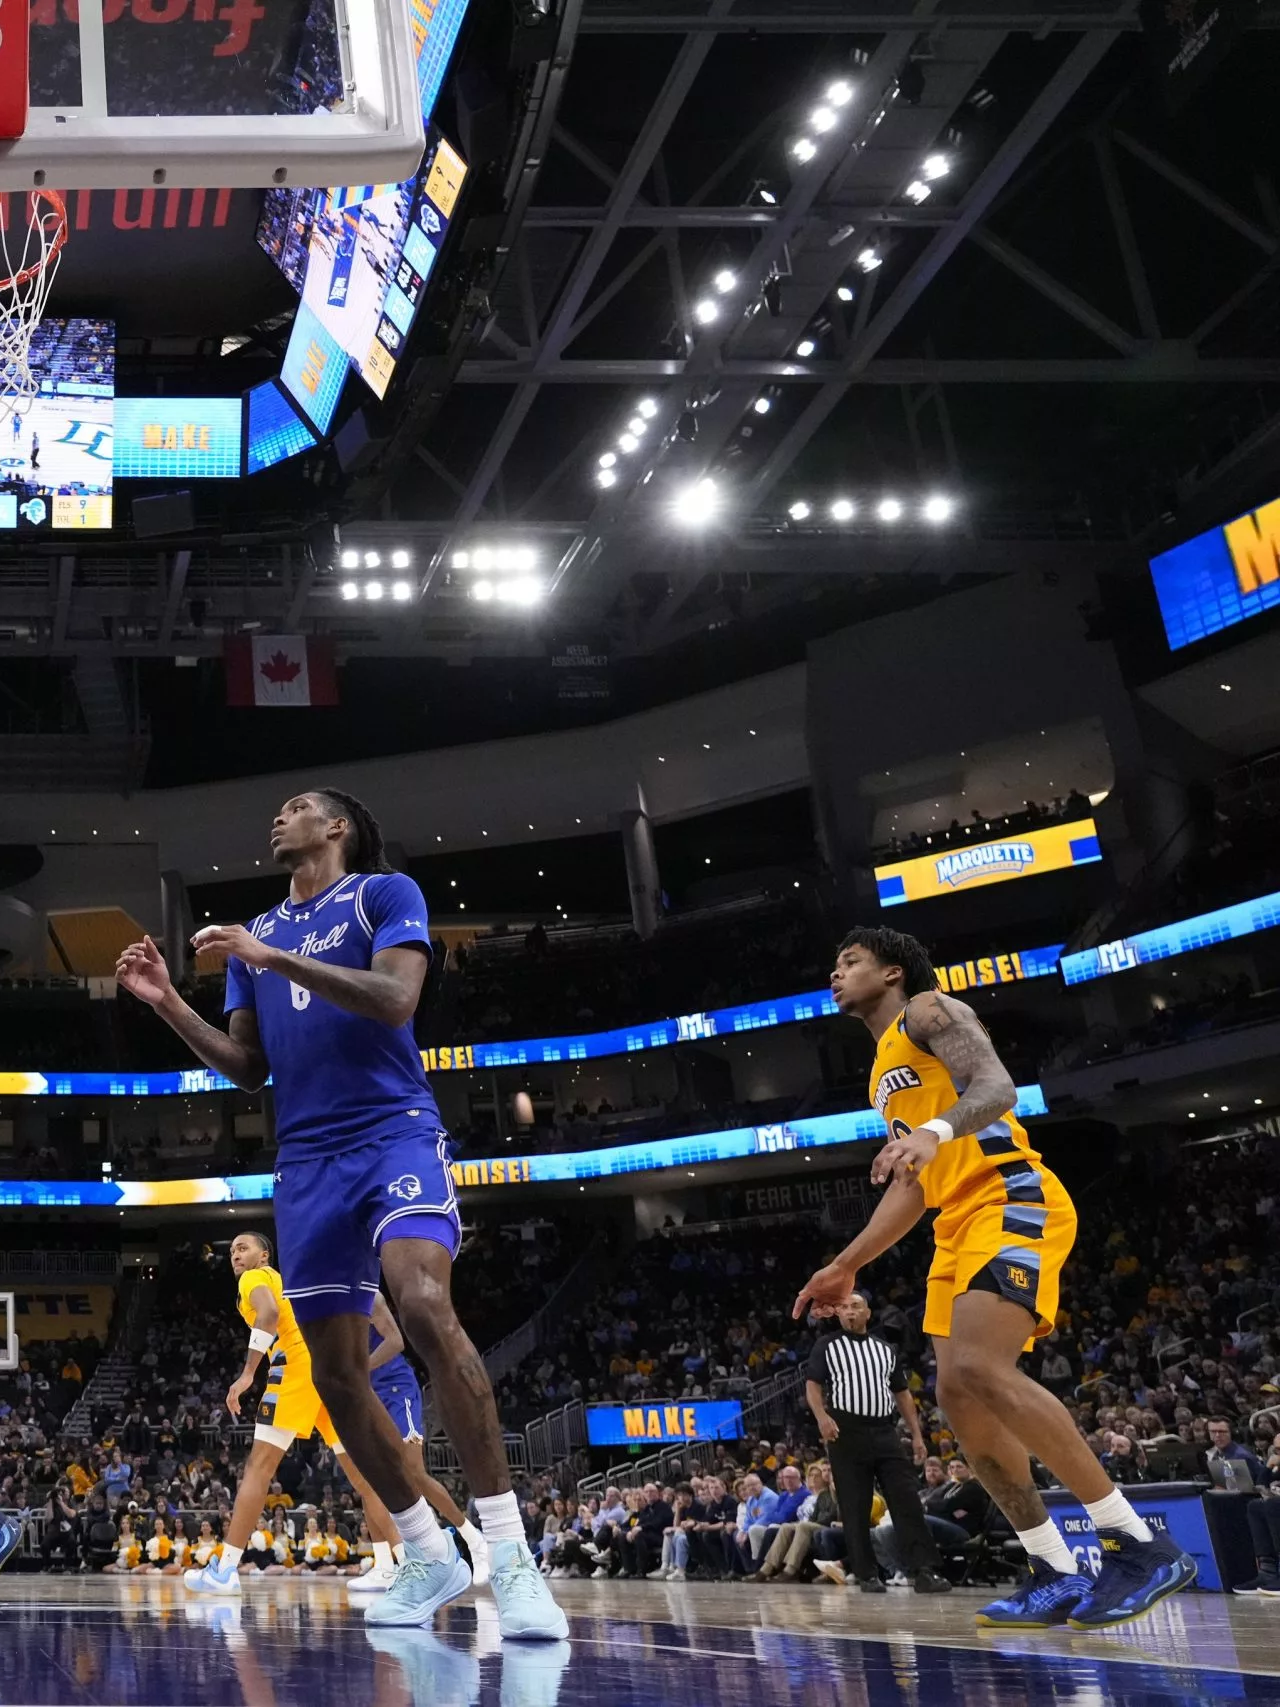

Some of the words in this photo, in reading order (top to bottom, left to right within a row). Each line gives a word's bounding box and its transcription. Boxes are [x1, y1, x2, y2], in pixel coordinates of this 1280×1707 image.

[142, 422, 210, 451] MAKE
[79, 499, 87, 510] 9
[936, 843, 1034, 883] MARQUETTE
[300, 921, 350, 957] Hall
[933, 952, 1024, 993] NOISE!
[745, 1186, 792, 1211] FEAR
[794, 1182, 832, 1205] THE
[1006, 1264, 1031, 1290] MU
[622, 1405, 697, 1439] MAKE
[1064, 1519, 1081, 1532] ONE
